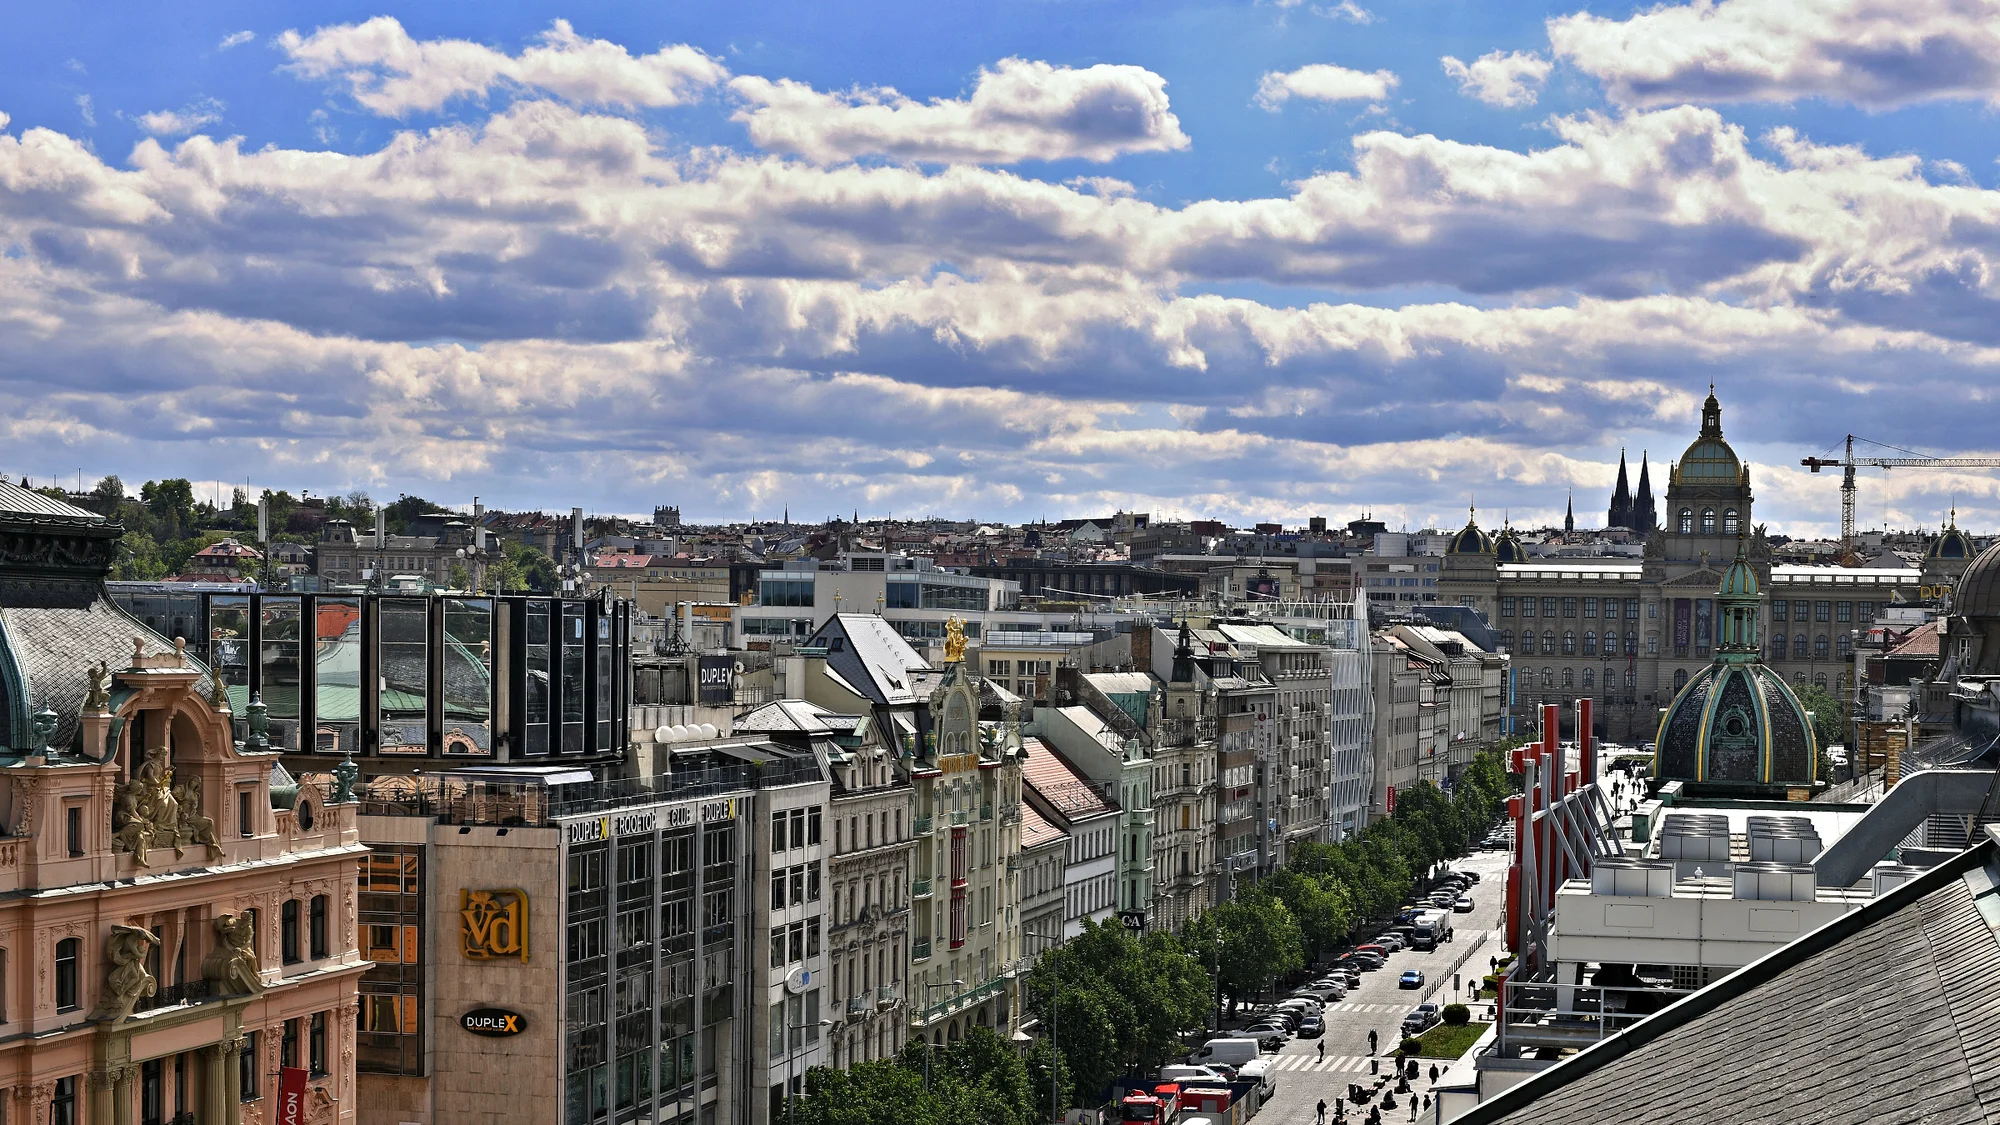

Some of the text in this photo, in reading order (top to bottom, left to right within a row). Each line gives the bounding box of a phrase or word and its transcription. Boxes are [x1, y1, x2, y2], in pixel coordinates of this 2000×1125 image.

[701, 668, 733, 690] DUPLEX
[570, 798, 736, 842] DUPLEX ROOFTOP CLUB DUPLEX
[467, 1015, 518, 1032] DUPLEX
